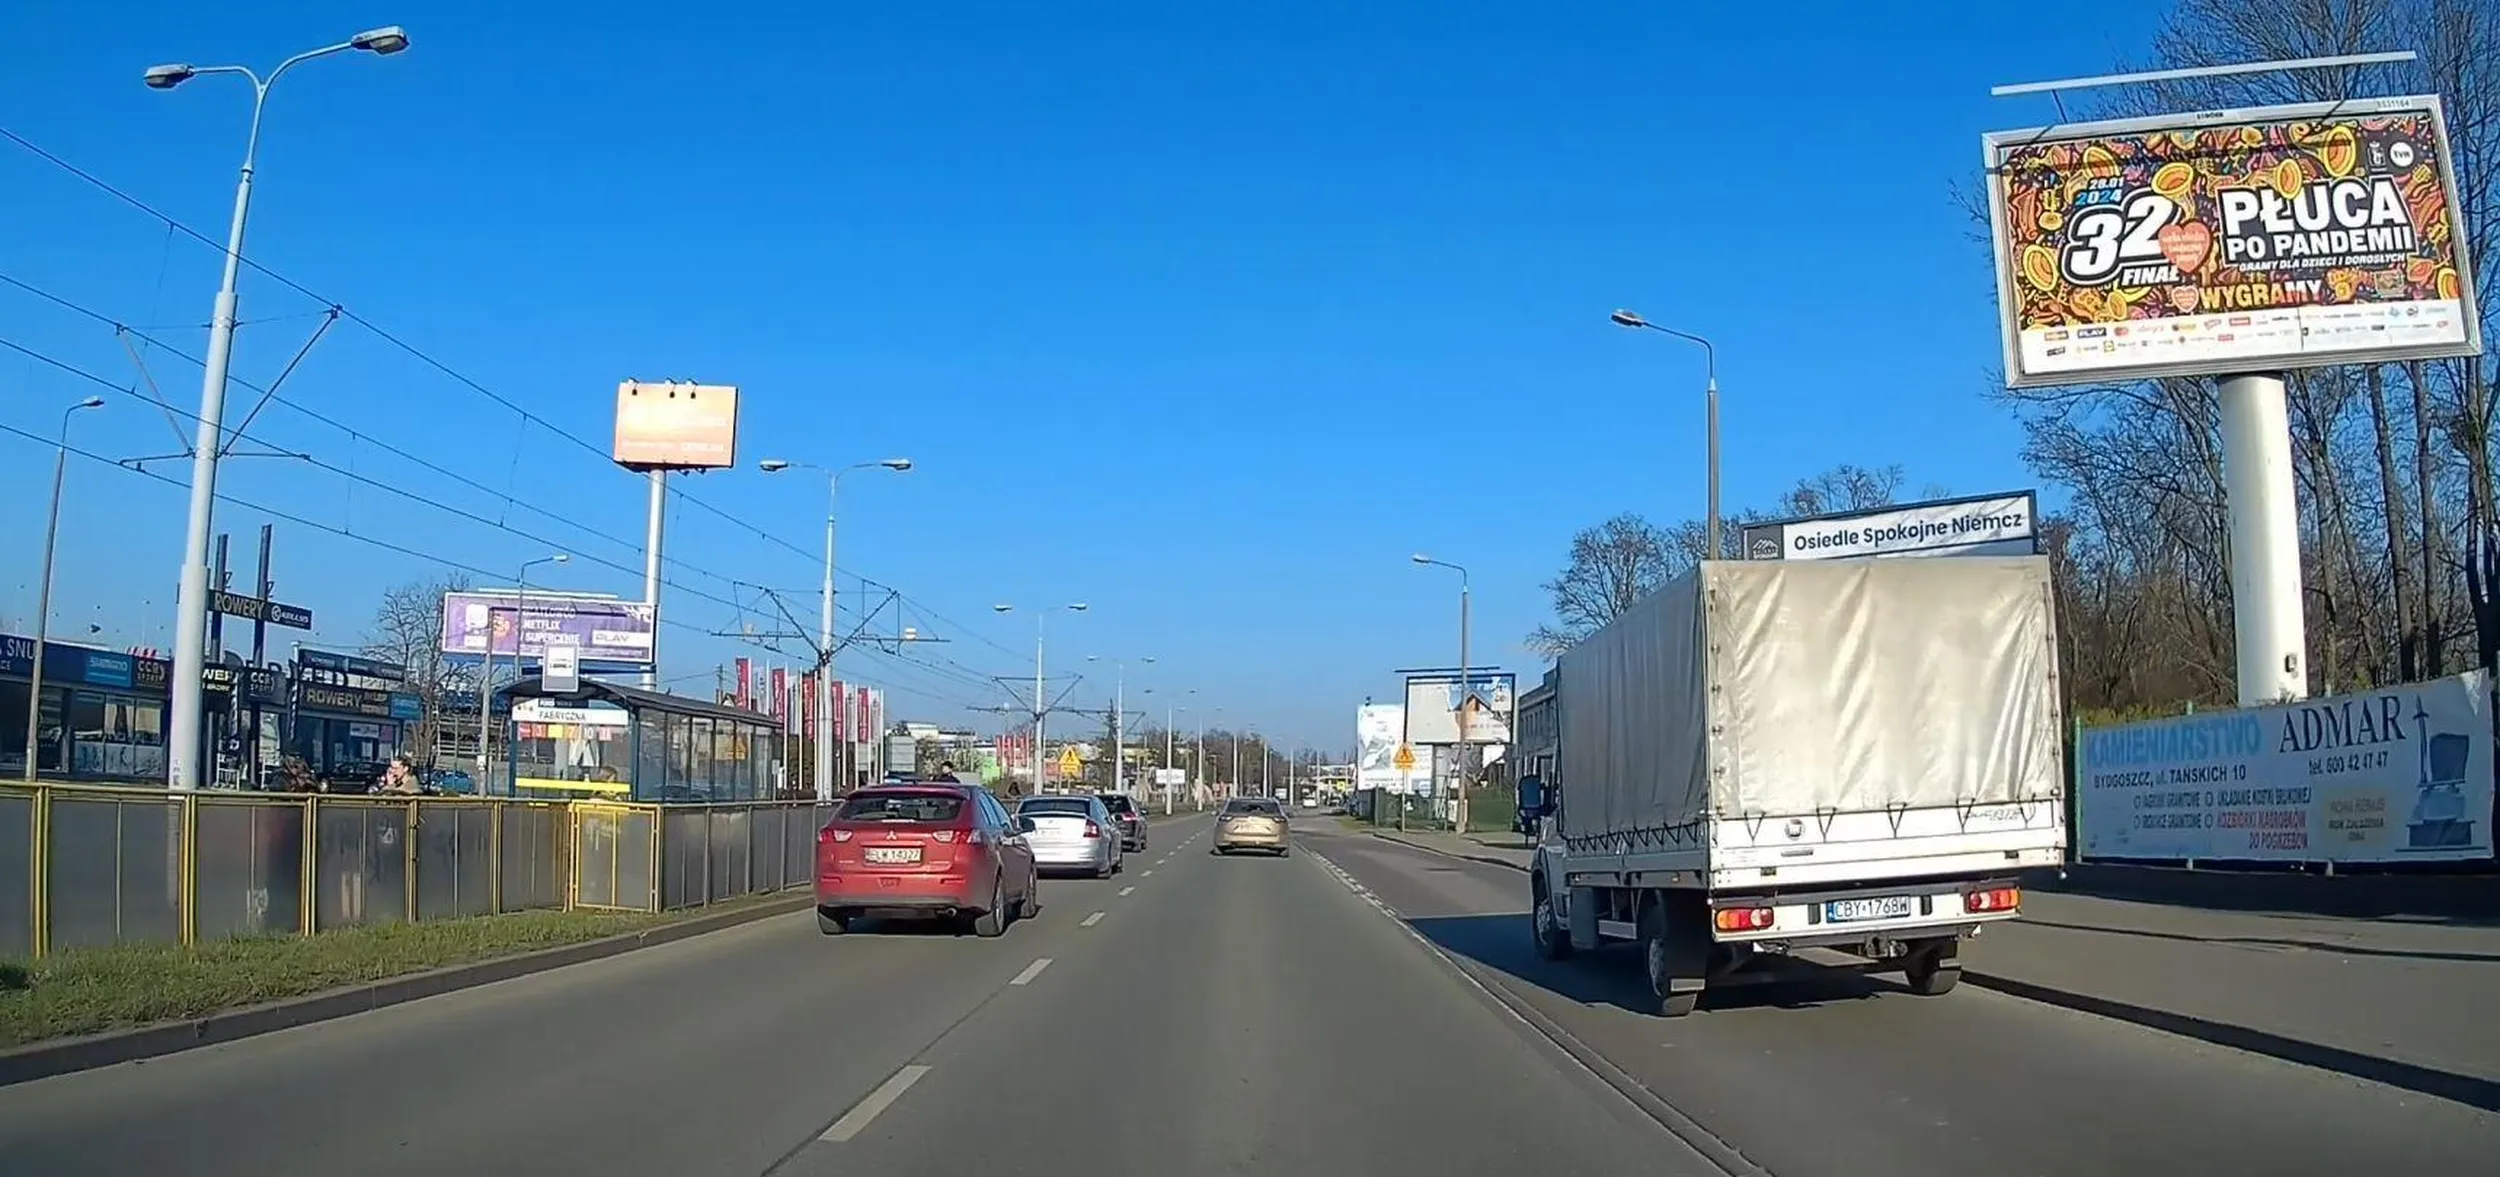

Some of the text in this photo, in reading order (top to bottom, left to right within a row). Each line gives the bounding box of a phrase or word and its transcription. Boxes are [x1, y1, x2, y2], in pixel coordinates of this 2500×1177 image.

[2088, 177, 2124, 190] 28.01
[2075, 188, 2123, 206] 2024
[2219, 179, 2408, 236] PŁUCA
[2068, 193, 2176, 278] 32
[2226, 236, 2266, 262] PO
[2273, 226, 2413, 258] PANDEMII
[2121, 264, 2181, 286] FINAŁ
[2239, 252, 2406, 273] GRAMY DLA DZIECI I DOROSŁYCH
[2199, 279, 2322, 310] WYGRAMY
[1793, 512, 2022, 551] Osiedle Spokojne Niemcz
[214, 592, 266, 620] ROWERY
[306, 688, 362, 708] ROWERY
[2087, 695, 2407, 767] KAMIENIARSTWO ADMAR
[2094, 771, 2154, 789] BYDGOSZCZ,
[2170, 764, 2228, 784] TAŃSKICH
[2232, 764, 2247, 781] 10
[1835, 896, 1908, 918] CBY 1768W
